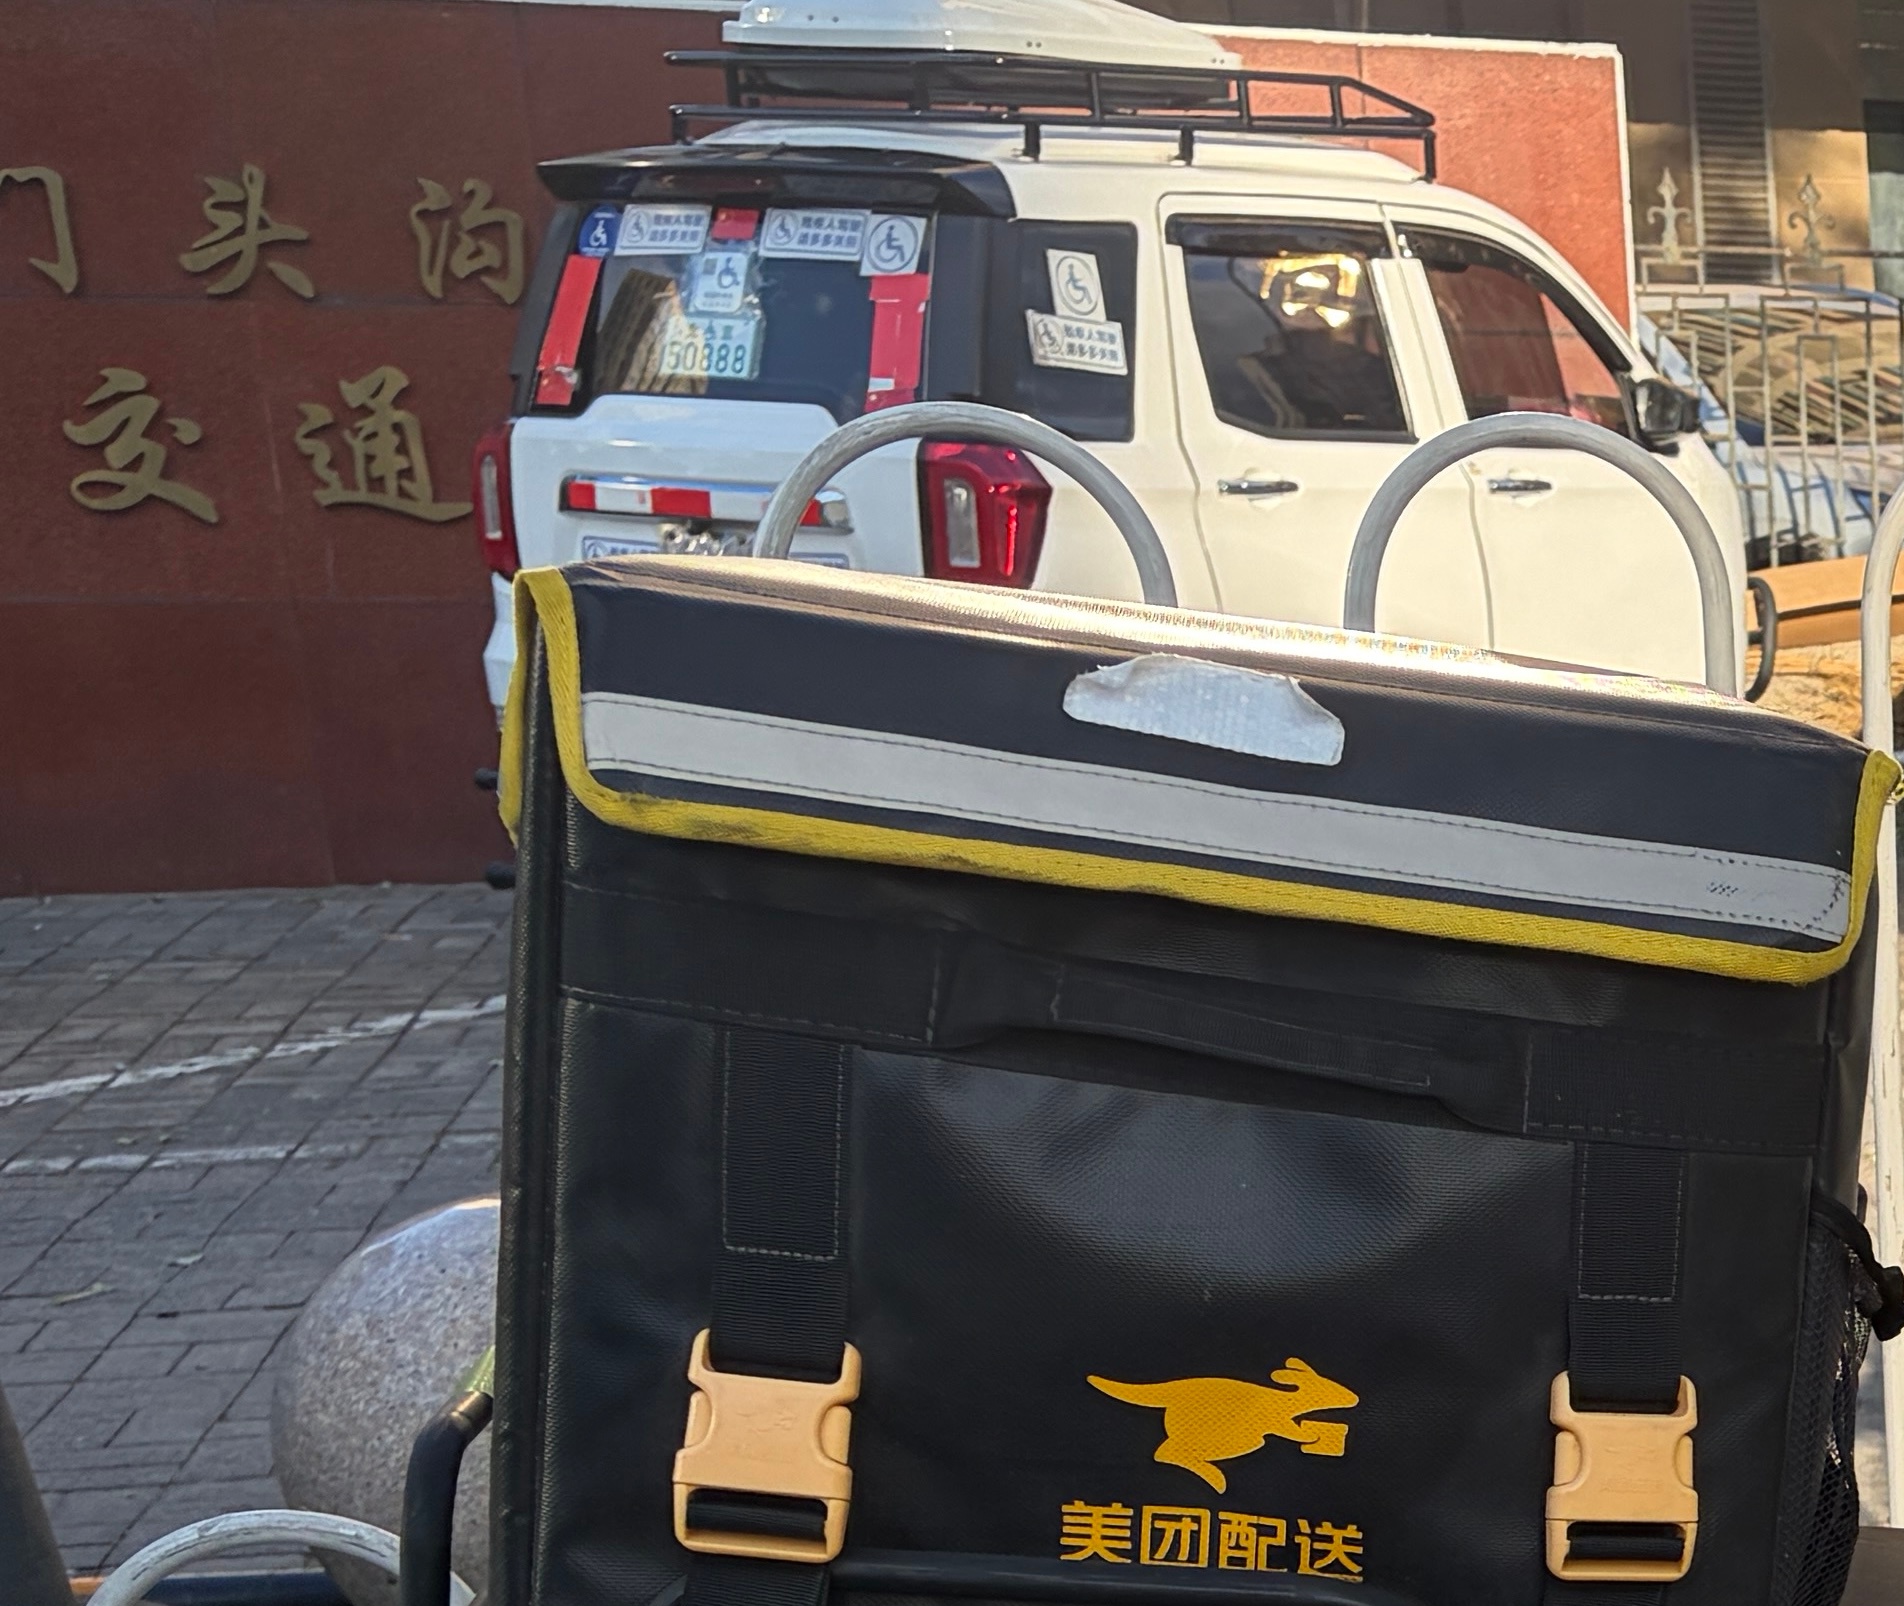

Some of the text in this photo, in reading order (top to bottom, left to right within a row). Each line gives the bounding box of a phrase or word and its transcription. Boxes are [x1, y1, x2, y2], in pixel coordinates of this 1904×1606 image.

[63, 366, 474, 524] 交通
[1059, 1500, 1364, 1583] 美团配送
